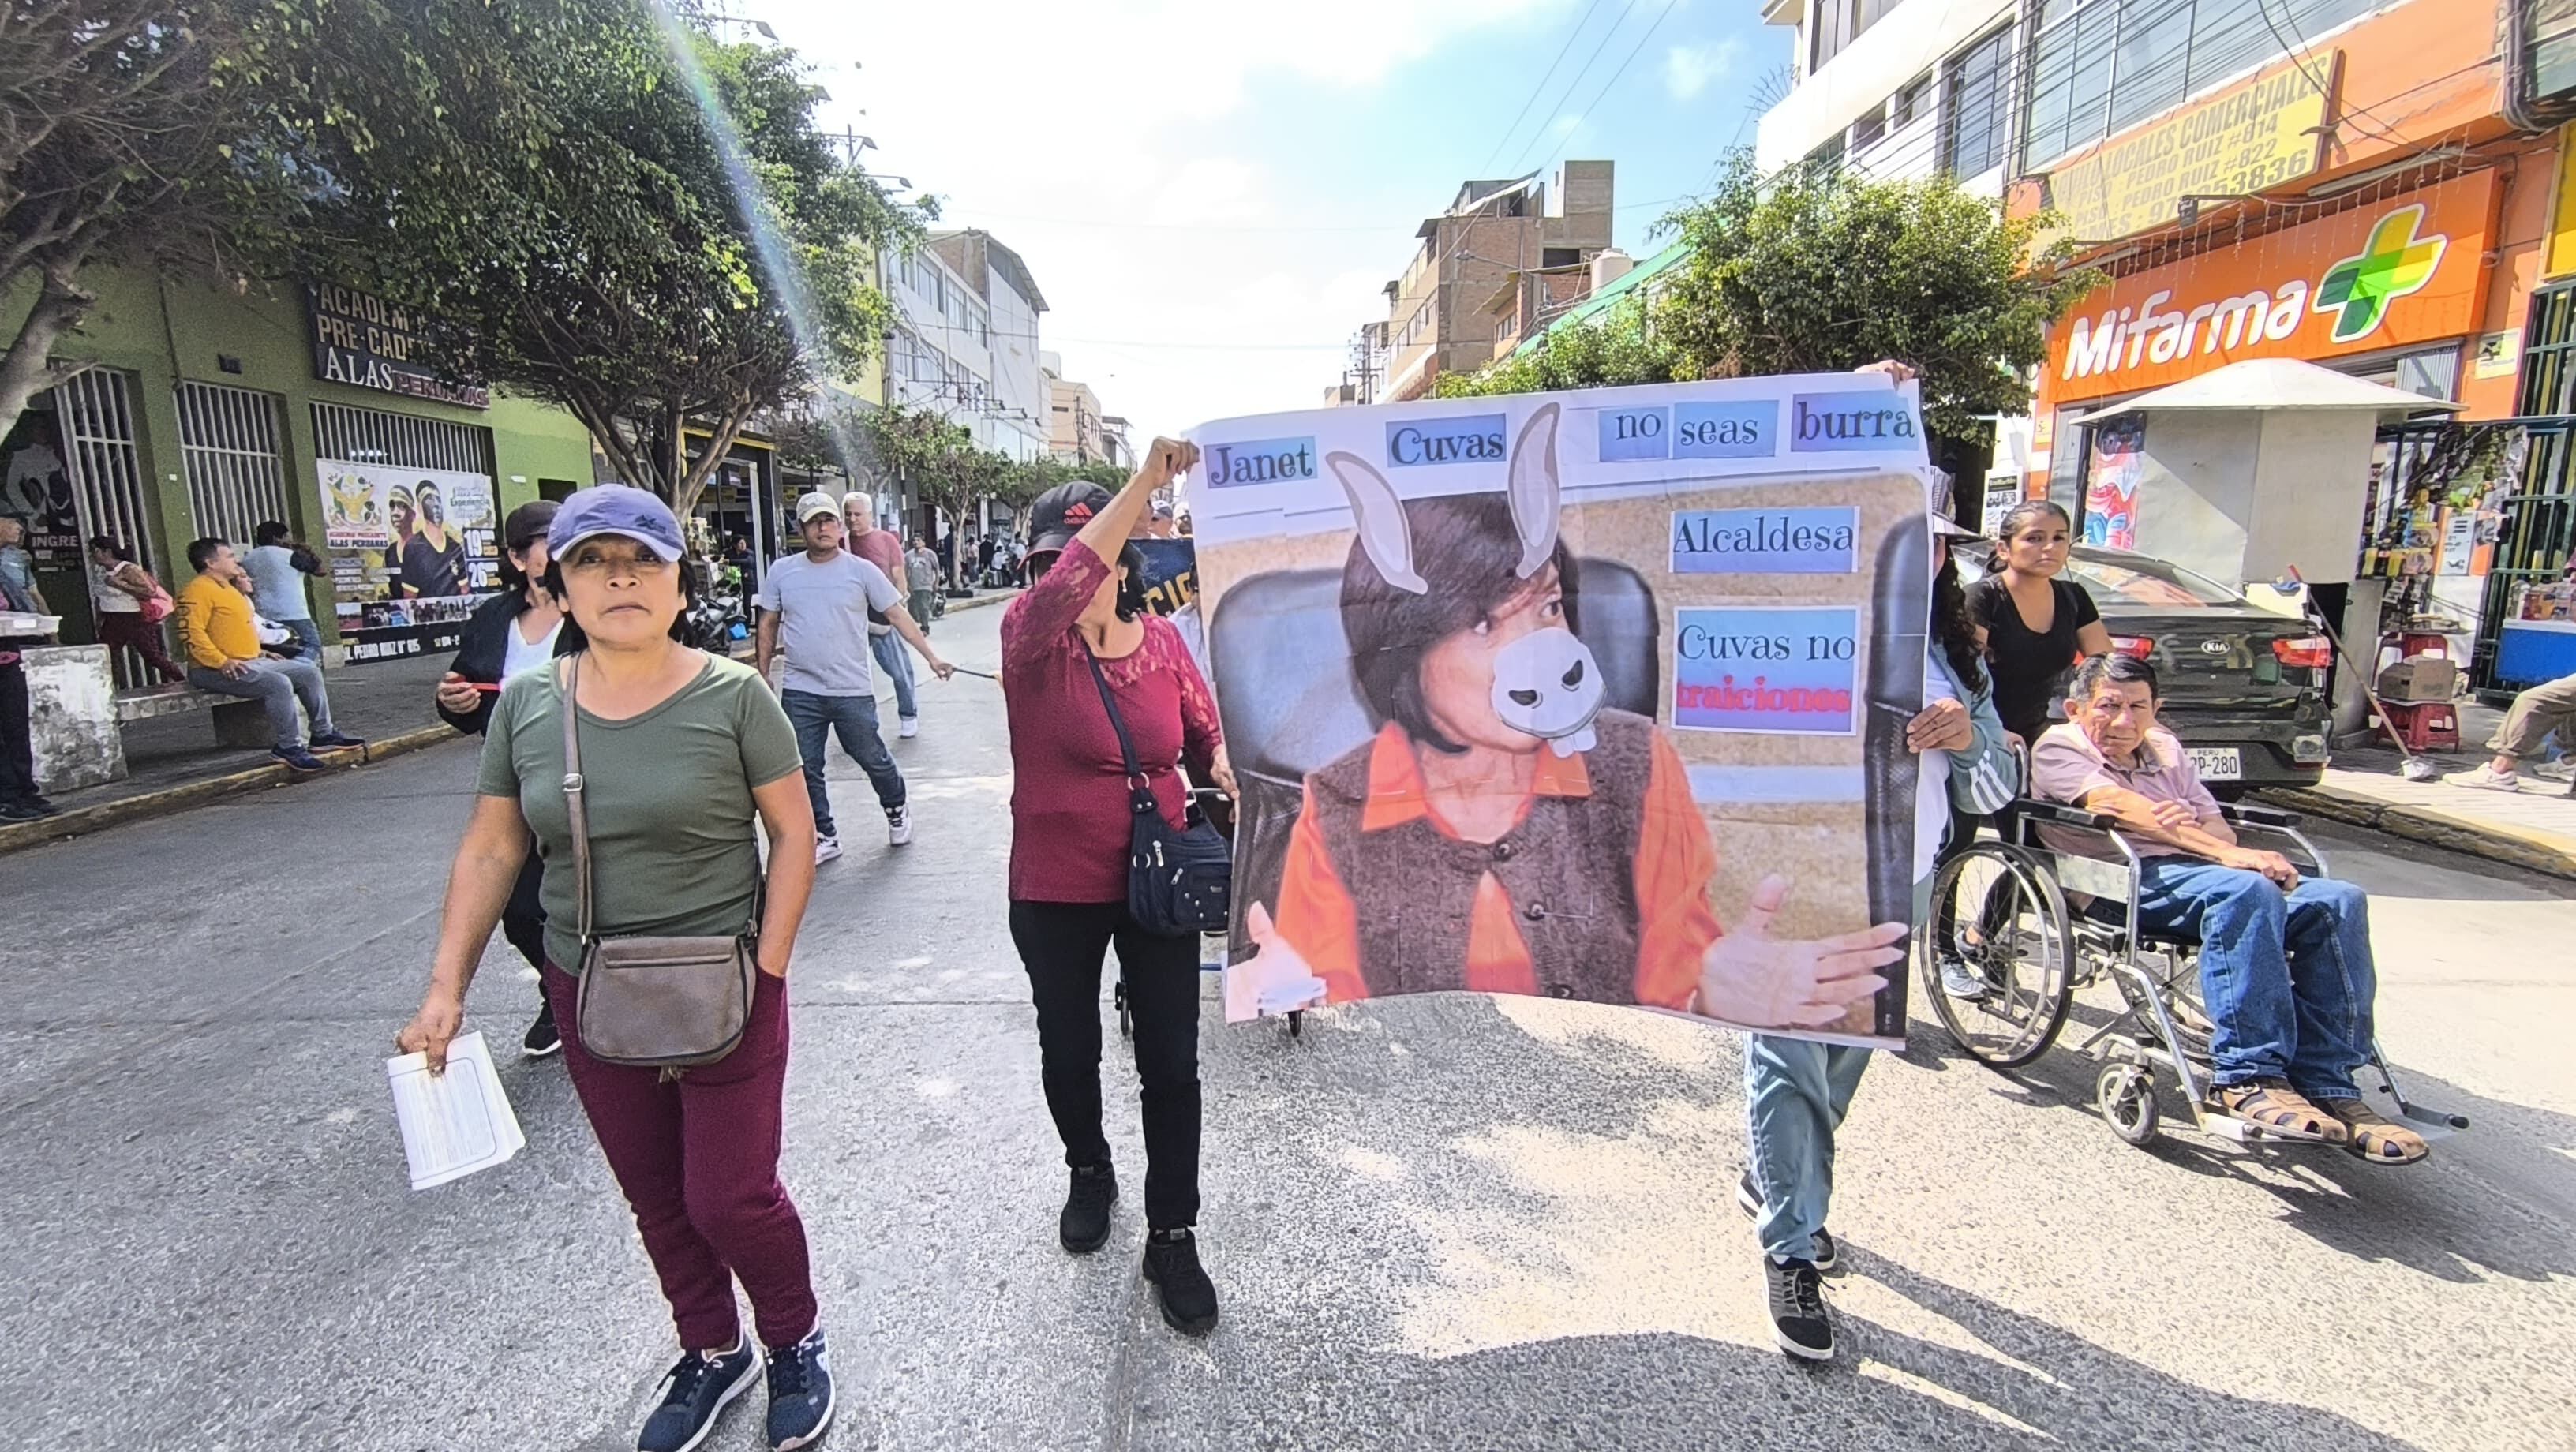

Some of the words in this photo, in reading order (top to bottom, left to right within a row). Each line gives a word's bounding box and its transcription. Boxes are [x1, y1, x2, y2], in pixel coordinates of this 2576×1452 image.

[2106, 125, 2177, 178] LOCALES
[2178, 56, 2328, 149] COMERCIALES
[2126, 153, 2180, 190] PEDRO
[2182, 134, 2224, 168] RUIZ
[2227, 112, 2279, 150] #814
[2121, 177, 2175, 212] PEDRO
[2177, 159, 2220, 192] RUIZ
[2223, 138, 2278, 175] #822
[2061, 279, 2309, 381] Mifarma
[324, 346, 393, 391] ALAS
[1211, 443, 1313, 485] Janet
[1391, 427, 1504, 466] Cuvas
[1615, 412, 1661, 441] no
[1679, 417, 1759, 447] seas
[1796, 400, 1915, 441] burra
[31, 535, 79, 548] INGRE
[464, 530, 483, 557] 19
[1672, 515, 1854, 553] Alcaldesa
[469, 562, 488, 588] 26
[1677, 624, 1791, 661] Cuvas
[1806, 634, 1855, 661] no
[2206, 642, 2226, 652] KIA
[1676, 674, 1852, 713] traiciones
